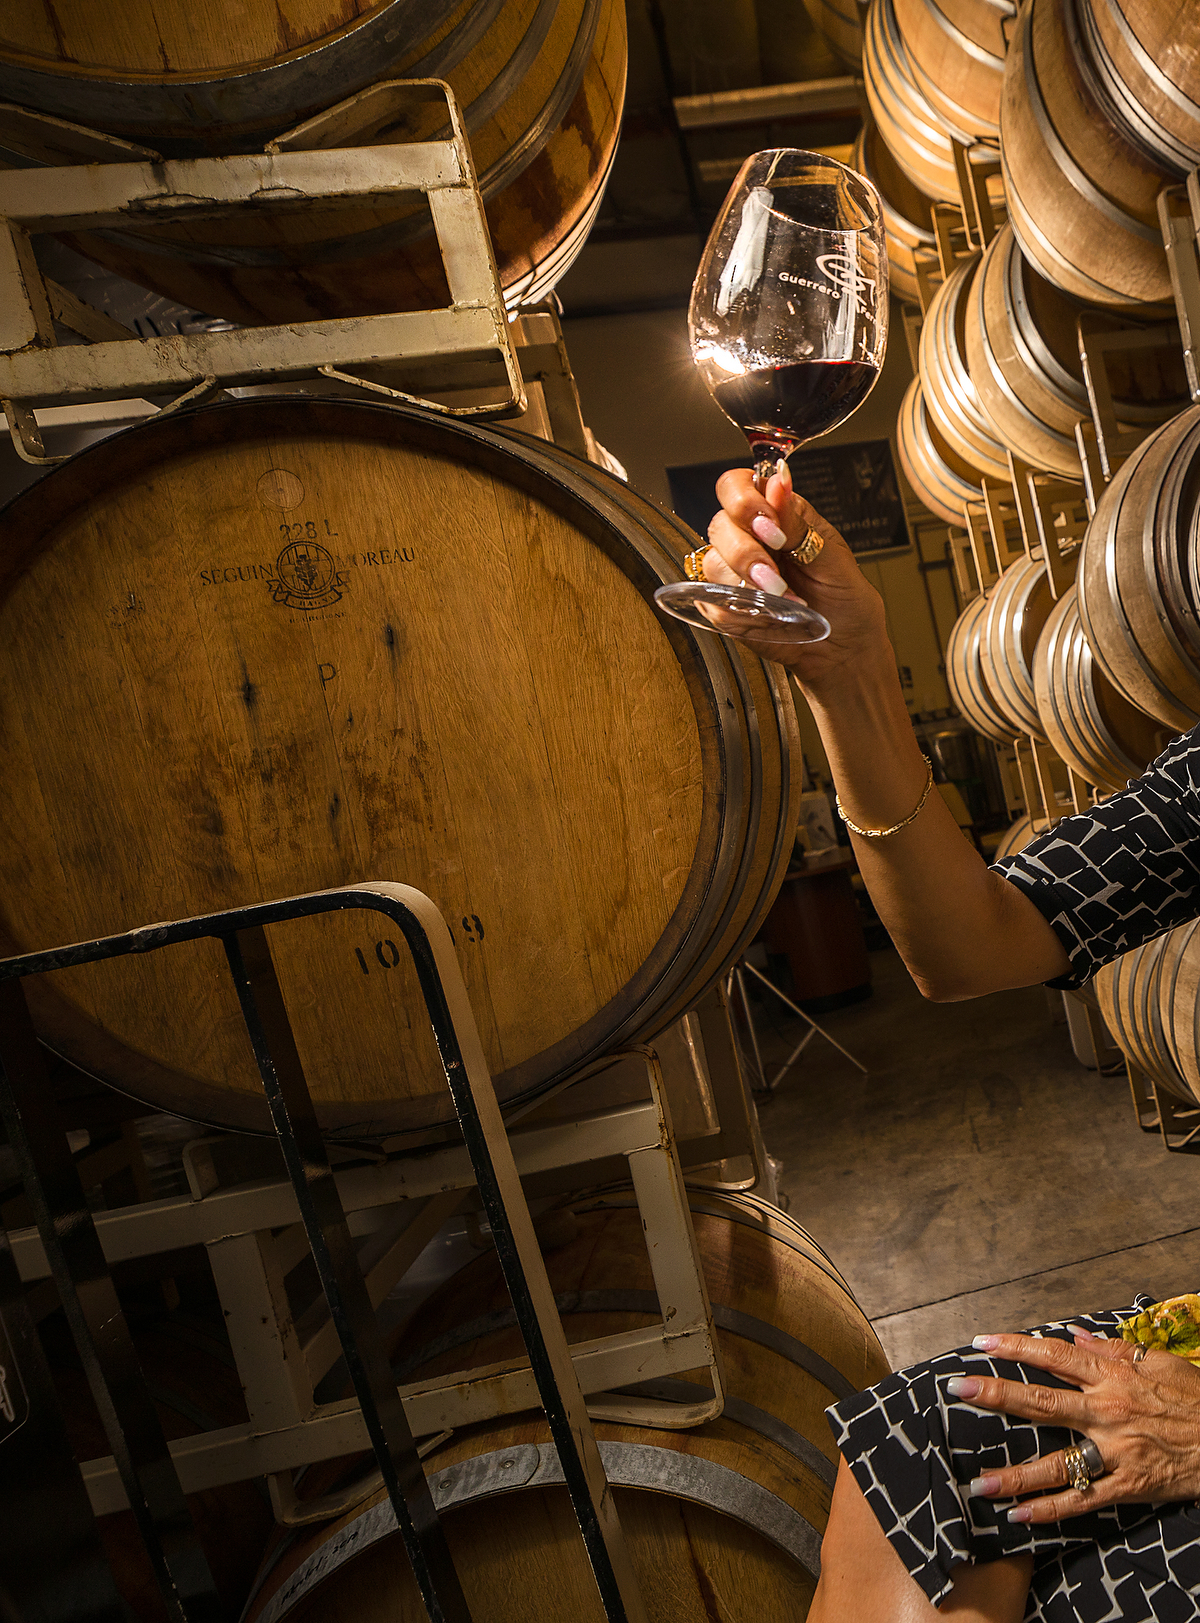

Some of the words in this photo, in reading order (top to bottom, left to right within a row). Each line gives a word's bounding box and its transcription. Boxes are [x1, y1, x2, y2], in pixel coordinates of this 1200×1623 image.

[779, 272, 841, 299] Guerrero
[279, 521, 318, 540] 228
[324, 519, 339, 536] L
[200, 564, 274, 586] SEGUIN
[318, 662, 337, 691] P
[354, 939, 400, 975] 10
